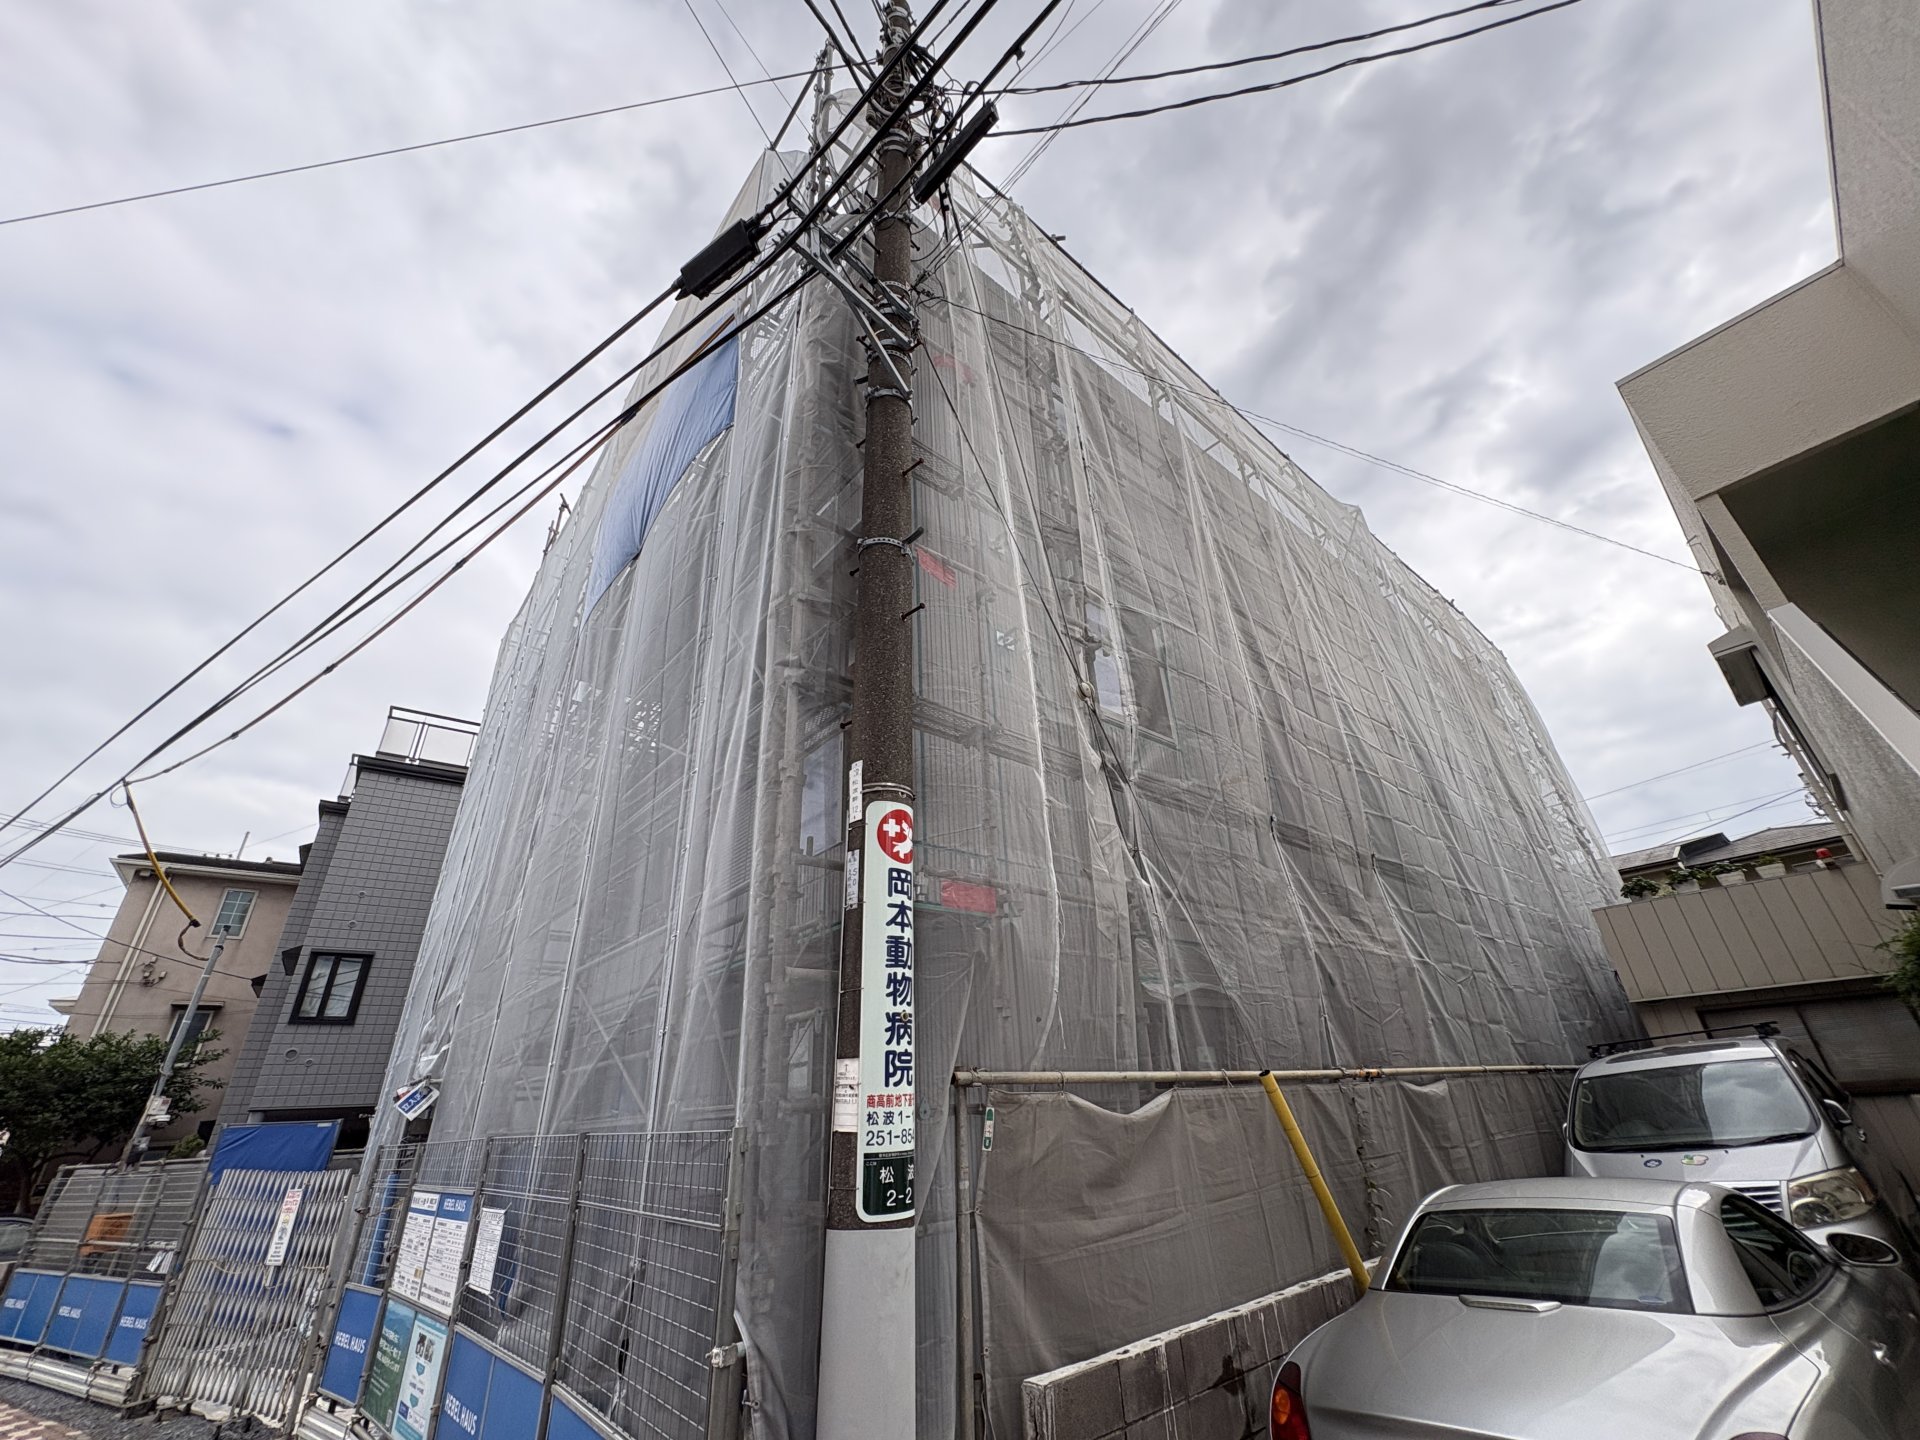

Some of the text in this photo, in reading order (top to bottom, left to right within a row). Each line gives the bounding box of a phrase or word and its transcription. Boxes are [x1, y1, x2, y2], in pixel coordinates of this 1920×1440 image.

[884, 867, 913, 1088] 岡本動物病院
[120, 1316, 148, 1330] HEBEL HAUS
[334, 1331, 350, 1349] HEBEL
[350, 1335, 367, 1354] HAUS
[444, 1393, 478, 1436] HEBEL HAUS
